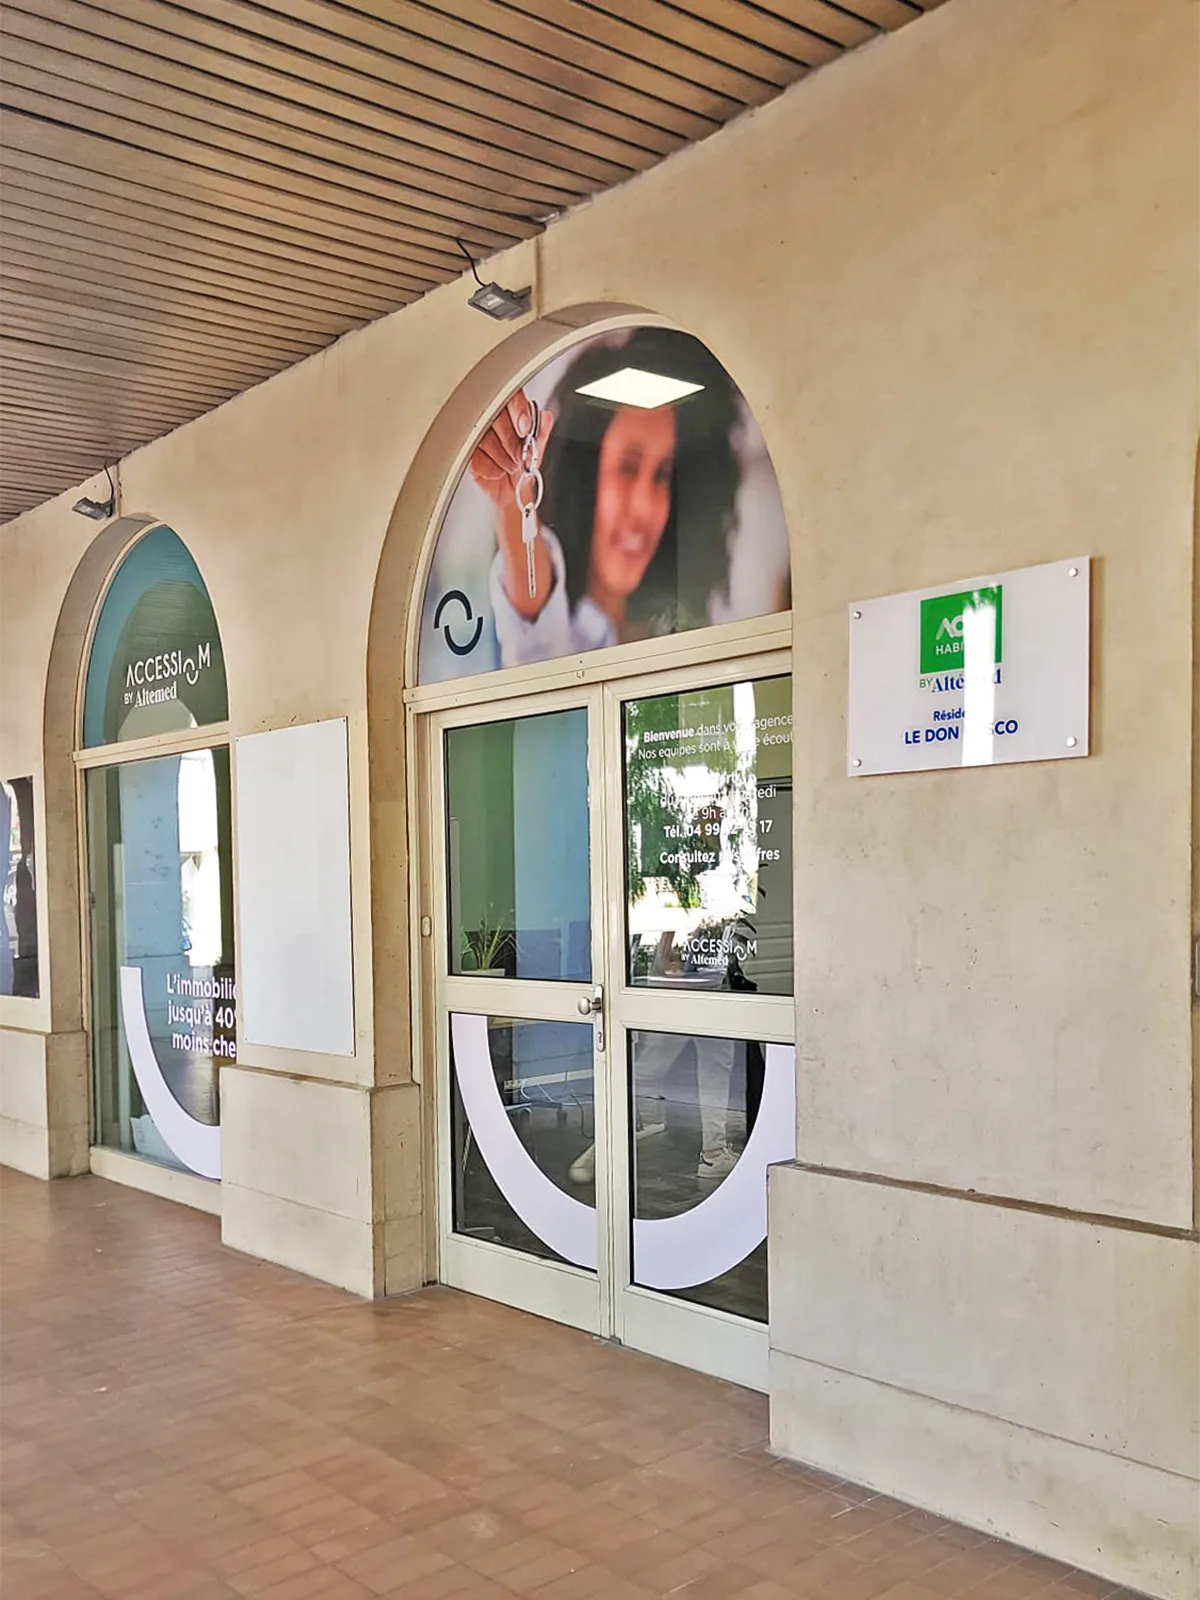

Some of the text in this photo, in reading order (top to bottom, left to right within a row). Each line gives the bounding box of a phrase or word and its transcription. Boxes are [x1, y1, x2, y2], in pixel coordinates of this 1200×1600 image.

[919, 668, 1002, 693] BY Altéd
[124, 692, 133, 704] BY
[643, 727, 695, 743] Bienvenue
[697, 720, 721, 735] dans
[754, 714, 793, 730] agence
[905, 731, 921, 745] LE
[925, 726, 959, 742] DON
[638, 749, 656, 760] Nos
[699, 736, 720, 753] sont
[704, 822, 720, 836] 99
[759, 819, 773, 834] 17
[660, 849, 716, 864] Consultez
[168, 1000, 213, 1028] jusqu'à
[172, 1031, 237, 1058] moins che
